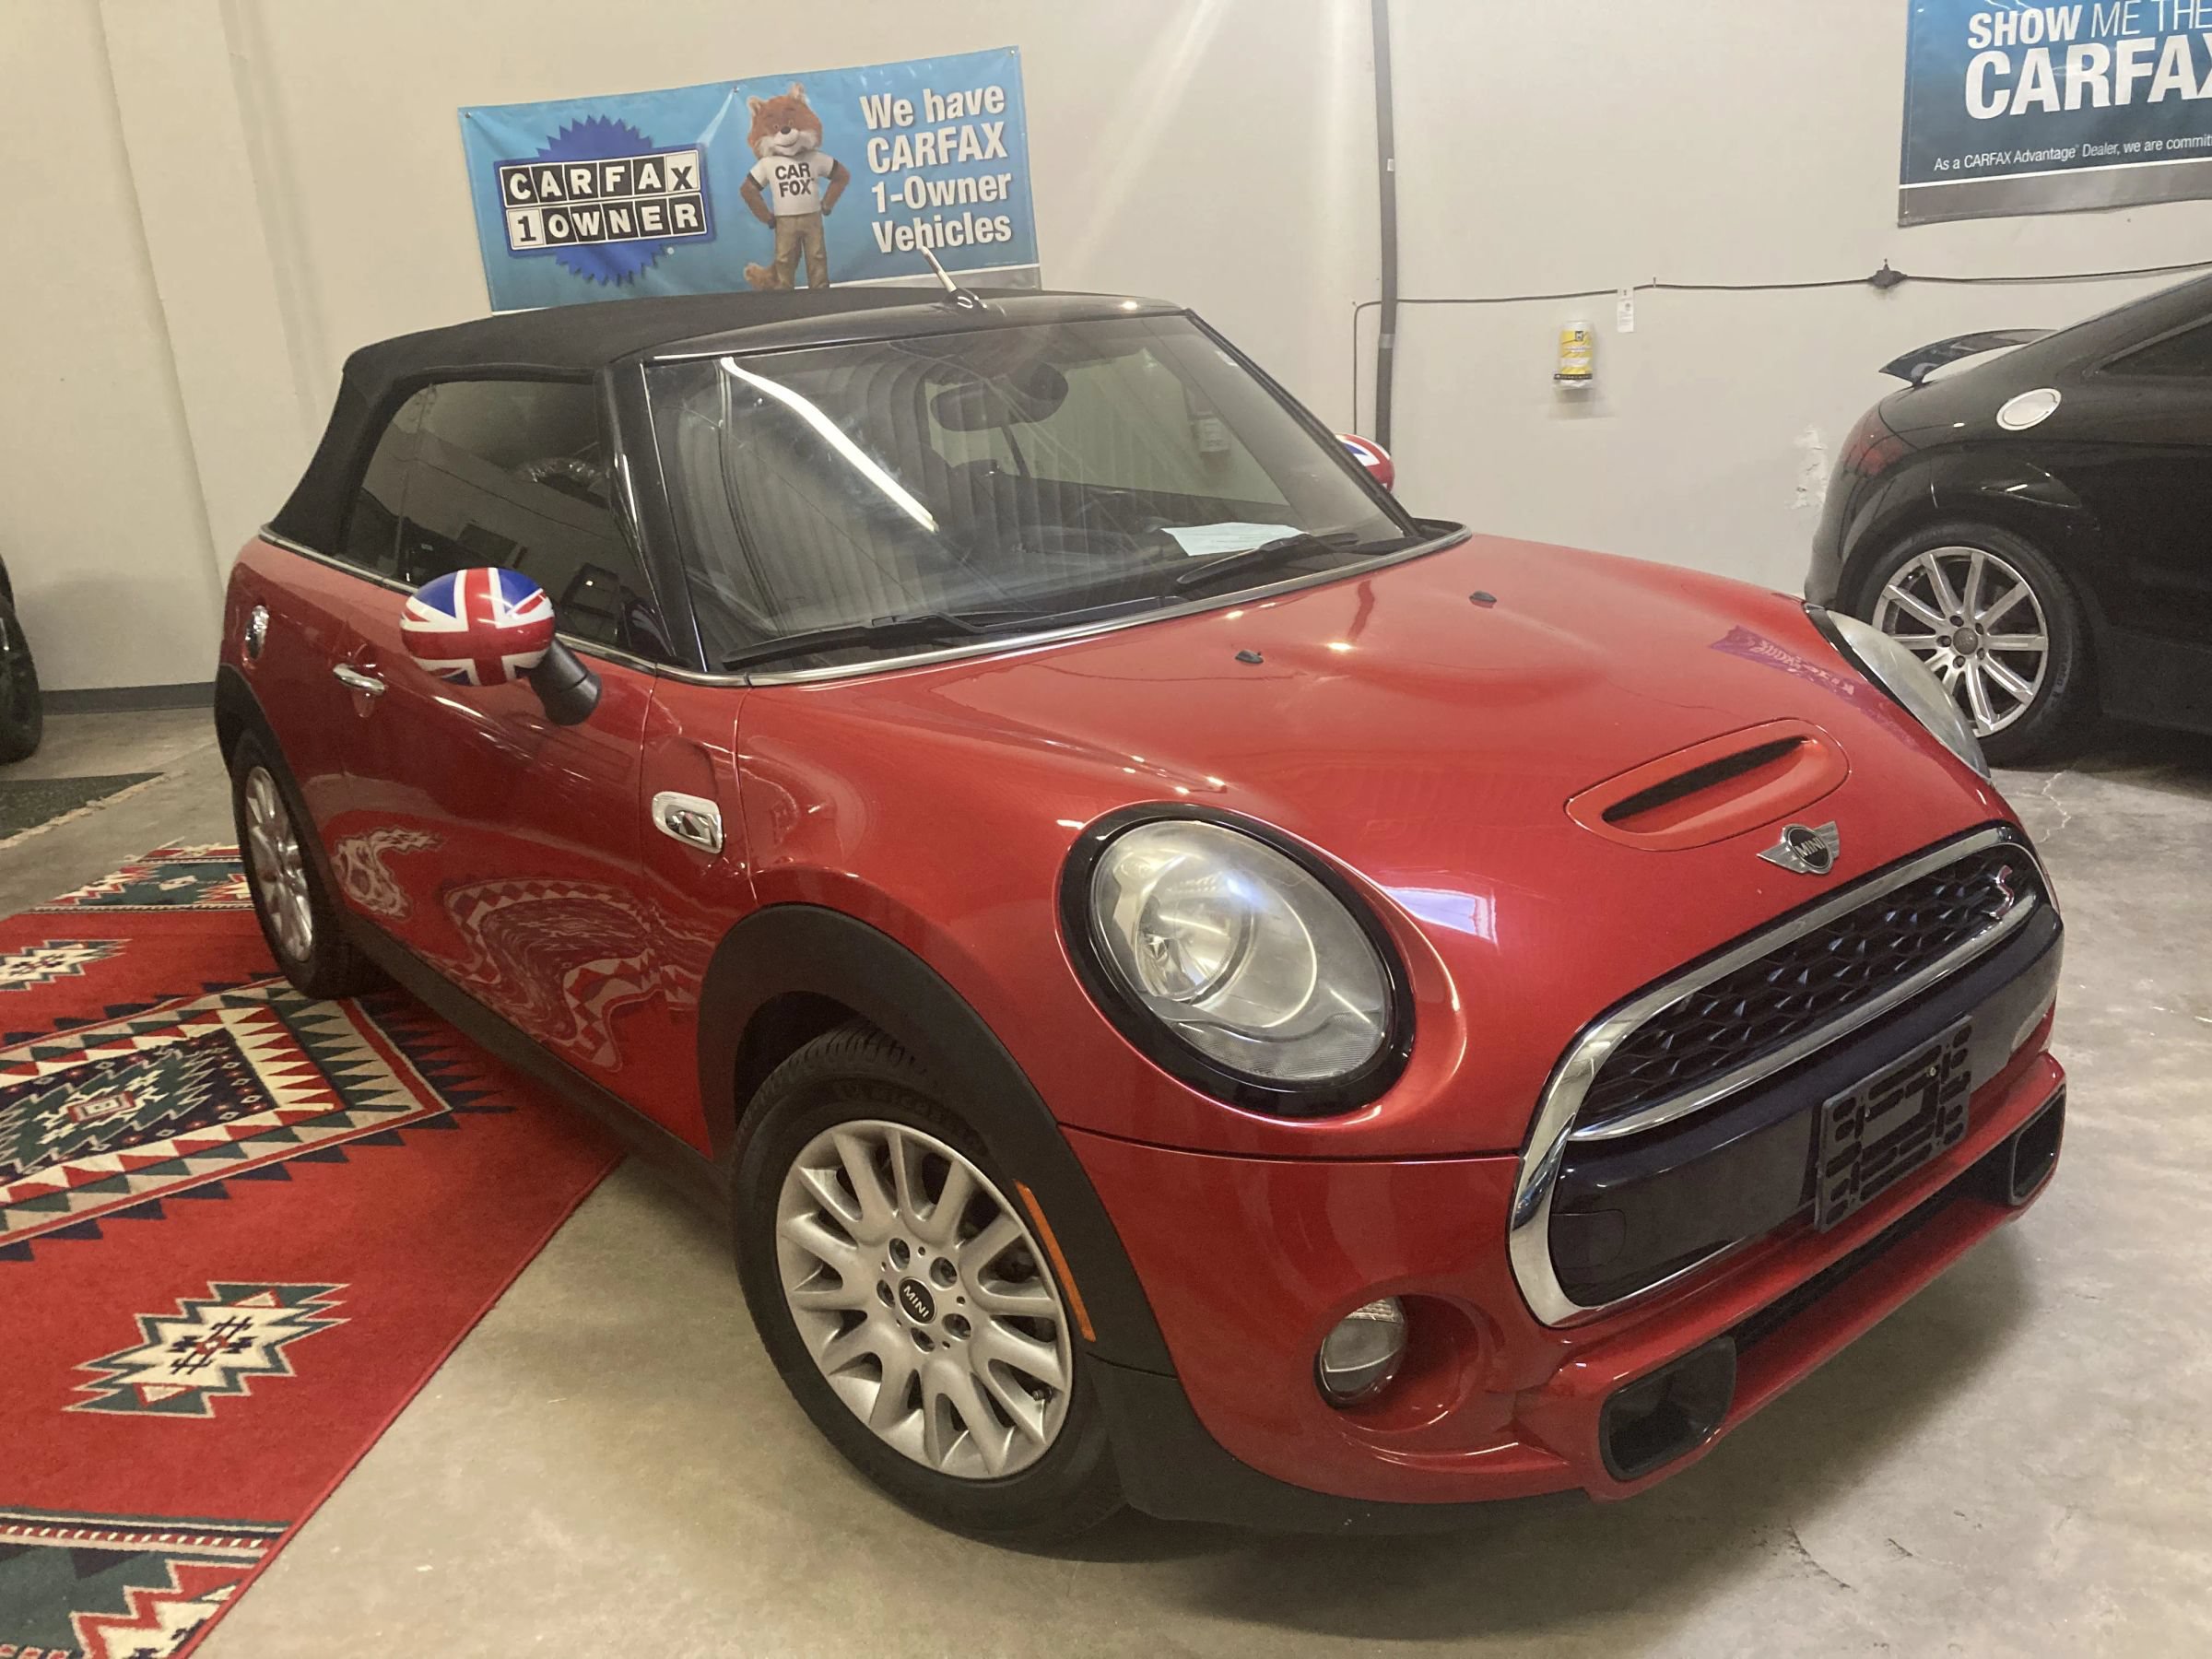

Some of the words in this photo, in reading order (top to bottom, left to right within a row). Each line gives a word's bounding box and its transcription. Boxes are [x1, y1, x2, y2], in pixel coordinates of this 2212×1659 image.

[1968, 5, 2083, 50] SHOW
[2090, 0, 2142, 38] ME
[859, 93, 914, 131] We
[923, 85, 1005, 124] have
[867, 121, 1008, 174] CARFAX
[1934, 158, 1949, 171] As
[1952, 159, 1960, 170] a
[1964, 151, 2012, 169] CARFAX
[2013, 147, 2076, 163] Advantage
[2082, 142, 2120, 157] Dealer,
[2124, 142, 2141, 153] we
[2145, 140, 2163, 151] are
[2166, 134, 2212, 149] commit
[509, 162, 694, 201] CARFAX
[775, 162, 811, 180] CAR
[779, 179, 811, 197] FOX
[871, 172, 1012, 213] 1-Owner
[872, 212, 1012, 253] Vehicles
[1794, 836, 1825, 858] MINI
[903, 1285, 930, 1319] MINI
